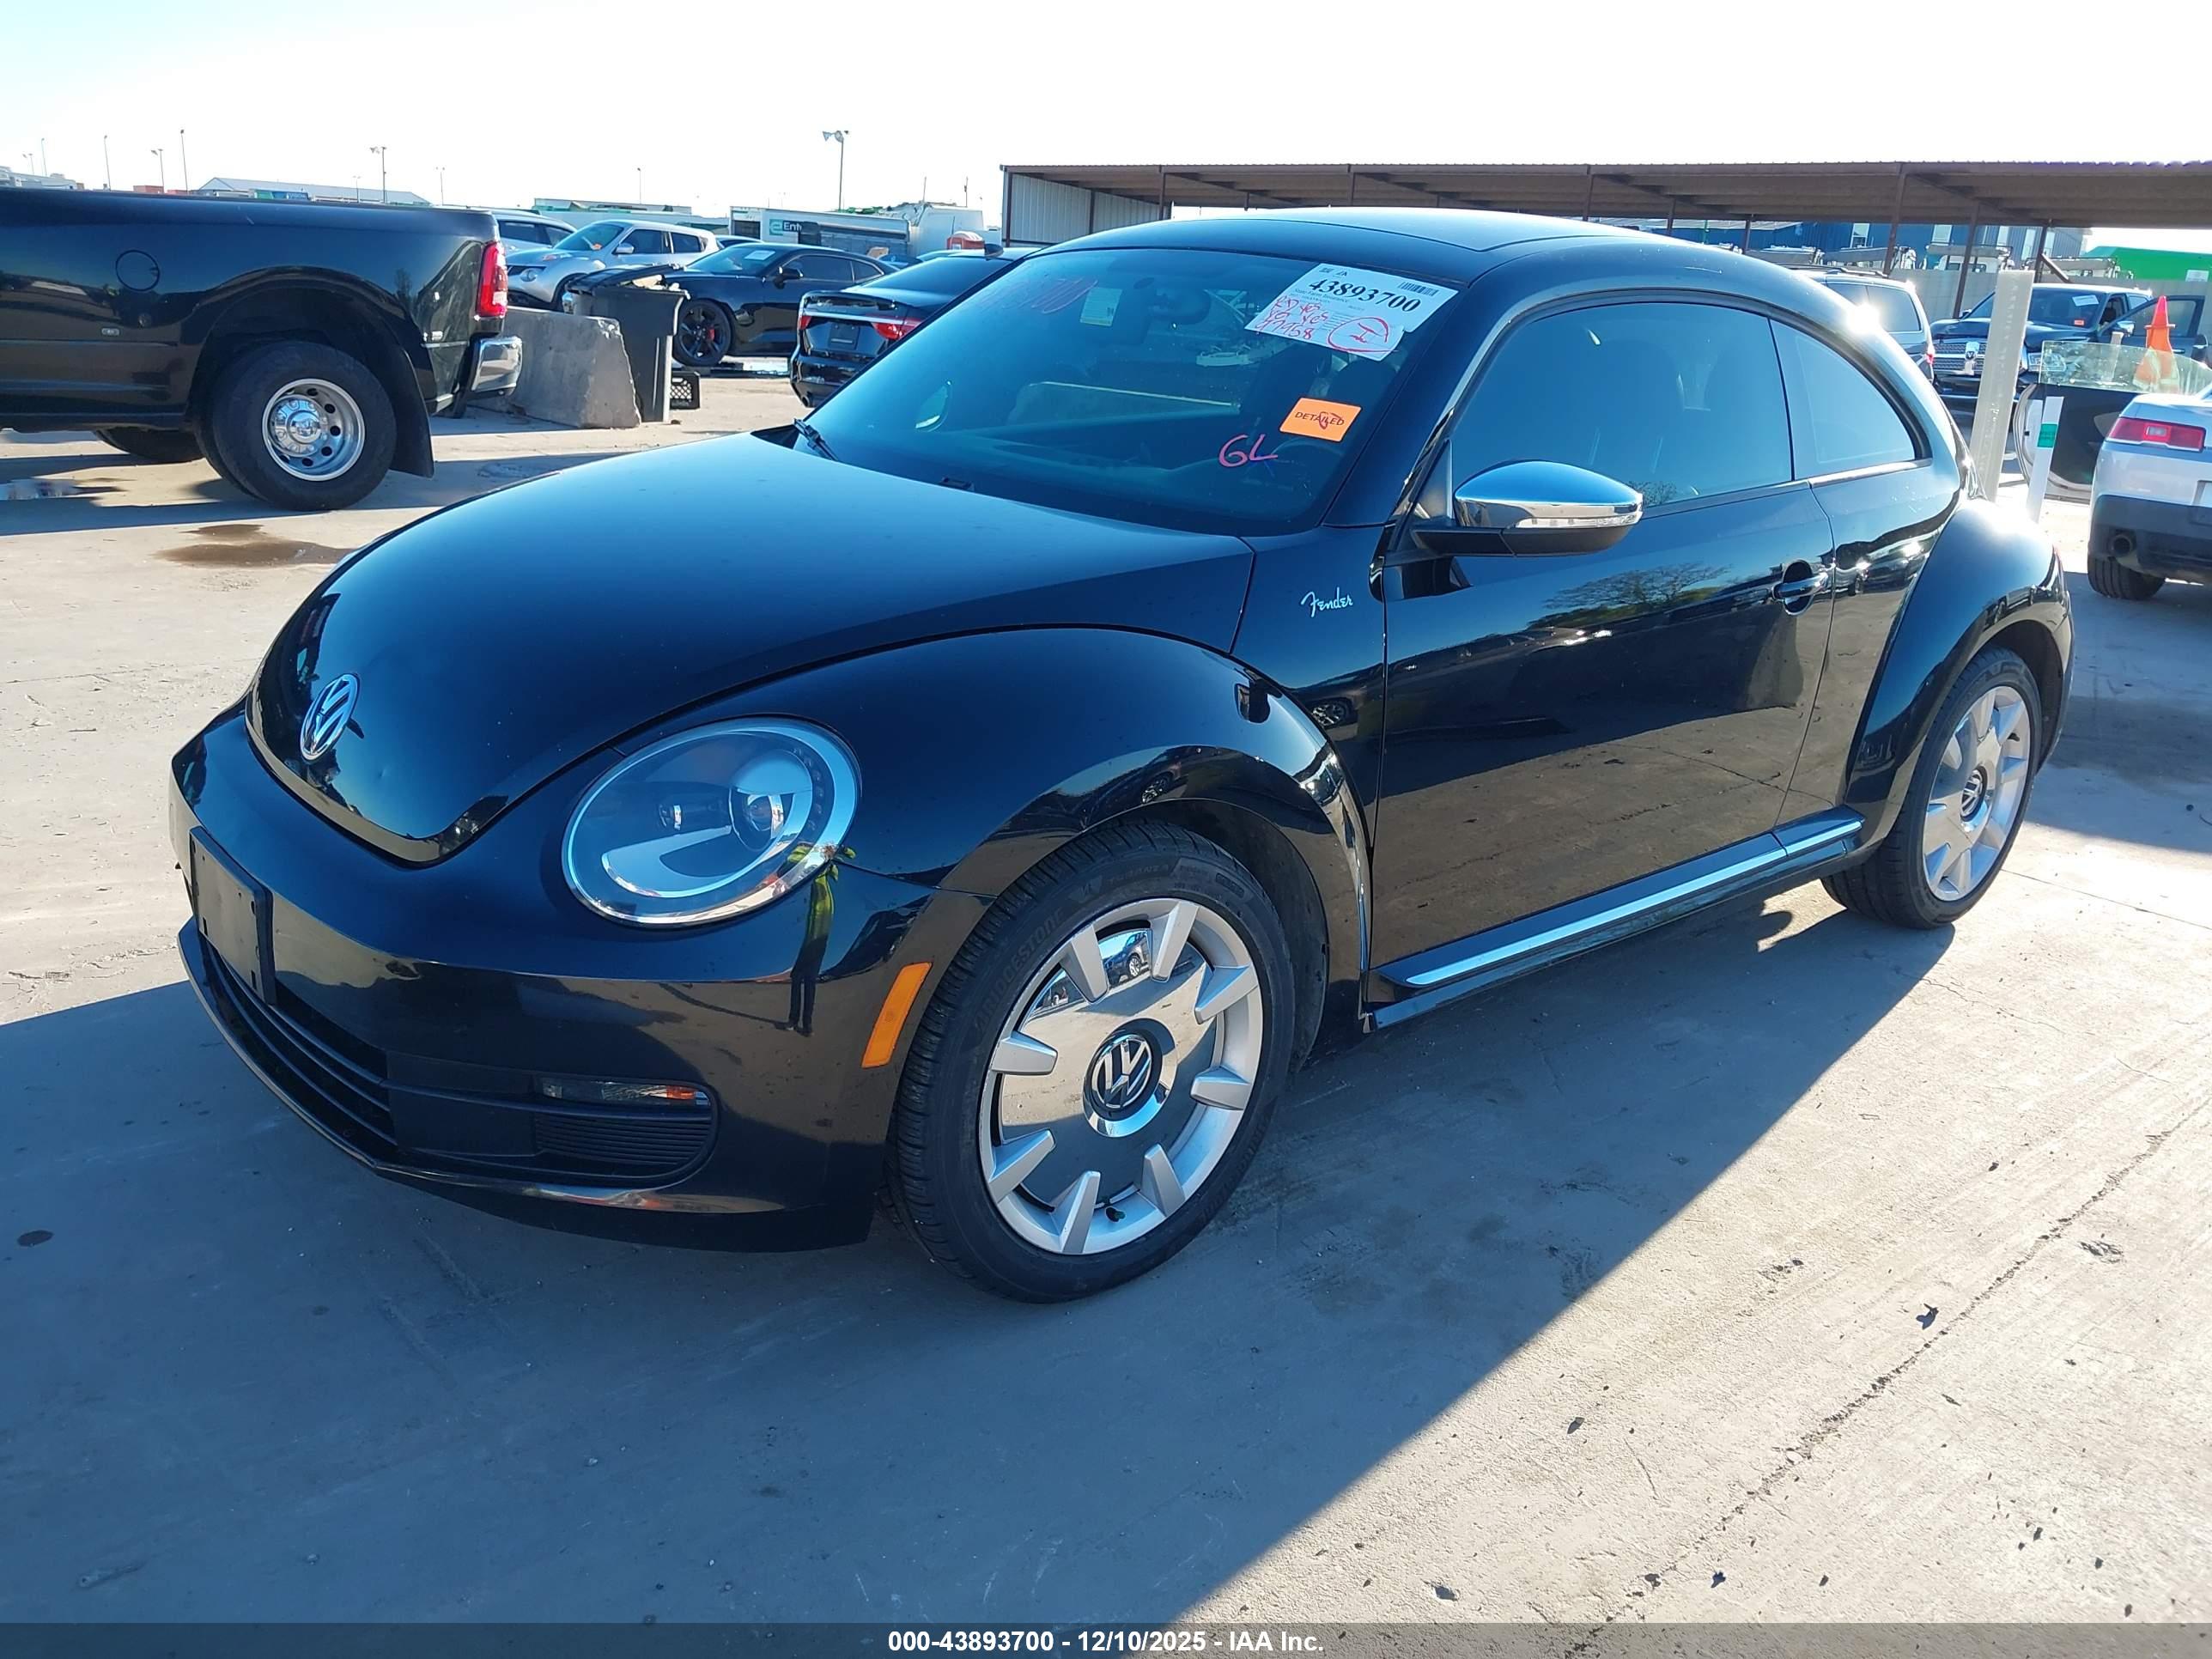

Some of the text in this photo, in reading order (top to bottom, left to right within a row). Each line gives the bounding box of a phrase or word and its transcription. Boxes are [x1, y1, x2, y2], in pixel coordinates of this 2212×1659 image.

[1309, 278, 1422, 313] 43893700
[1294, 410, 1346, 427] DETAILED
[1300, 586, 1353, 618] Fender
